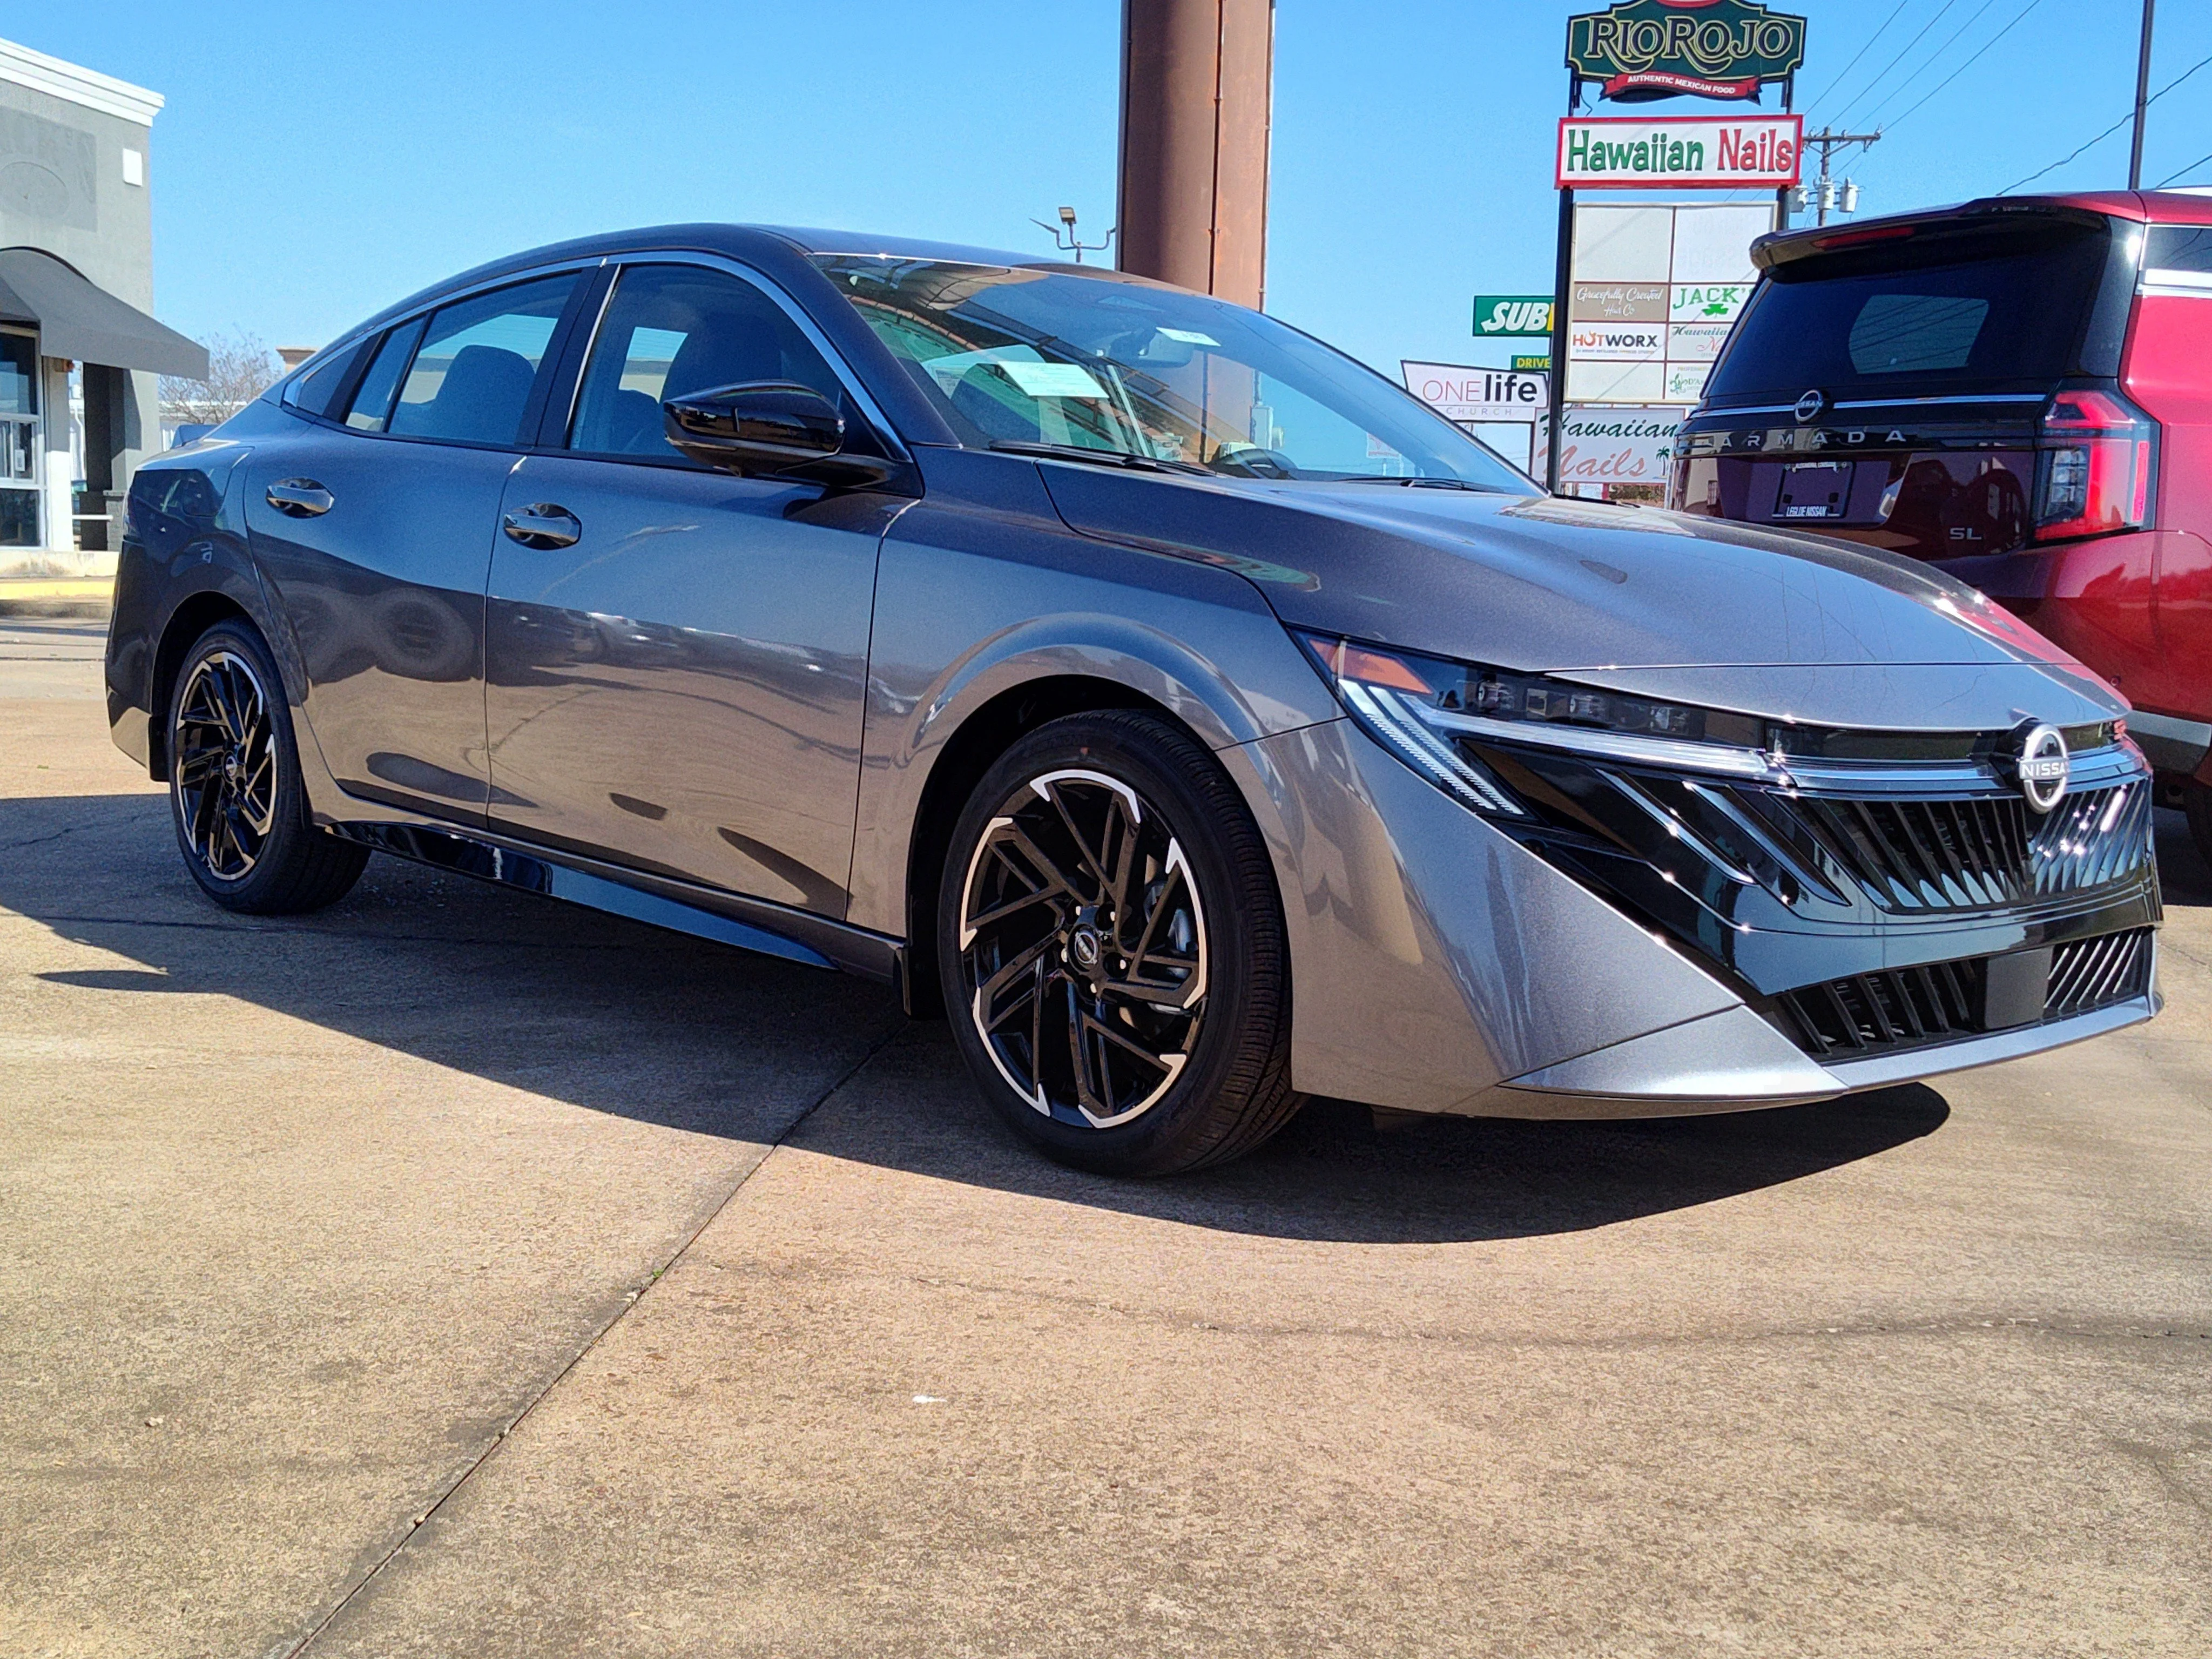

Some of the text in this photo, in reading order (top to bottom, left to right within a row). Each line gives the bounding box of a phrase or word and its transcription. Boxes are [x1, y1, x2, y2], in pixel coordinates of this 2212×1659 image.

[1627, 75, 1736, 95] AUTHENTIC MEXICAN FOOD
[1567, 128, 1792, 173] Hawaiian Nails
[1672, 326, 1728, 336] Hawaiia
[1573, 331, 1658, 347] HOTWORX
[1516, 357, 1550, 369] DRIVE
[1446, 407, 1512, 415] CHURCH
[1721, 430, 1907, 448] ARMADA
[1949, 527, 1982, 540] SL
